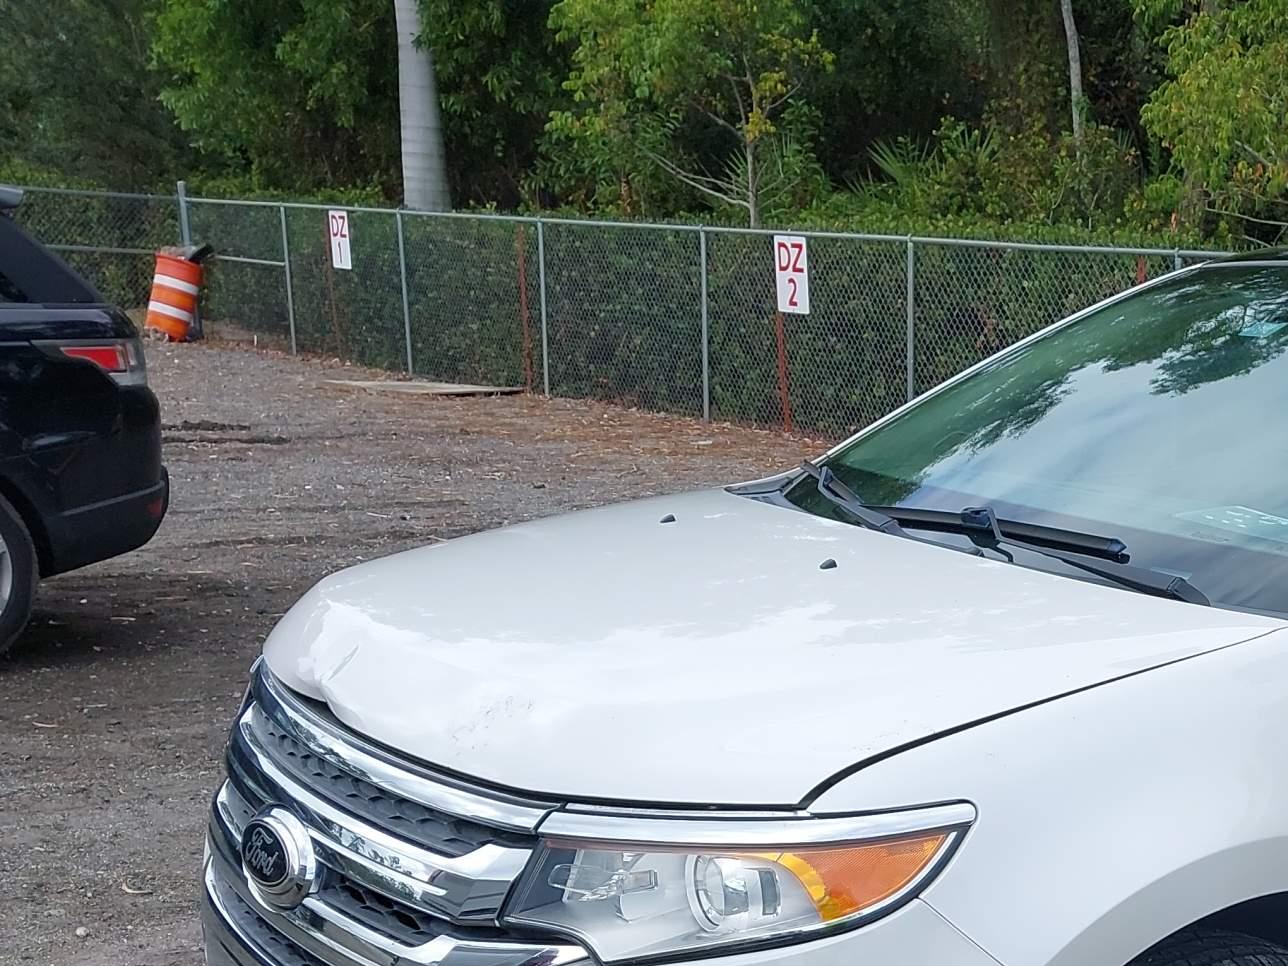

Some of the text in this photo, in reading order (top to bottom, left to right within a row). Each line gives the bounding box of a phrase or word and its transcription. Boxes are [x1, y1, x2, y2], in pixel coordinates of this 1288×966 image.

[331, 215, 347, 238] DZ
[337, 241, 343, 264] 1
[777, 242, 804, 273] DZ
[788, 278, 798, 306] 2
[245, 827, 279, 876] Ford
